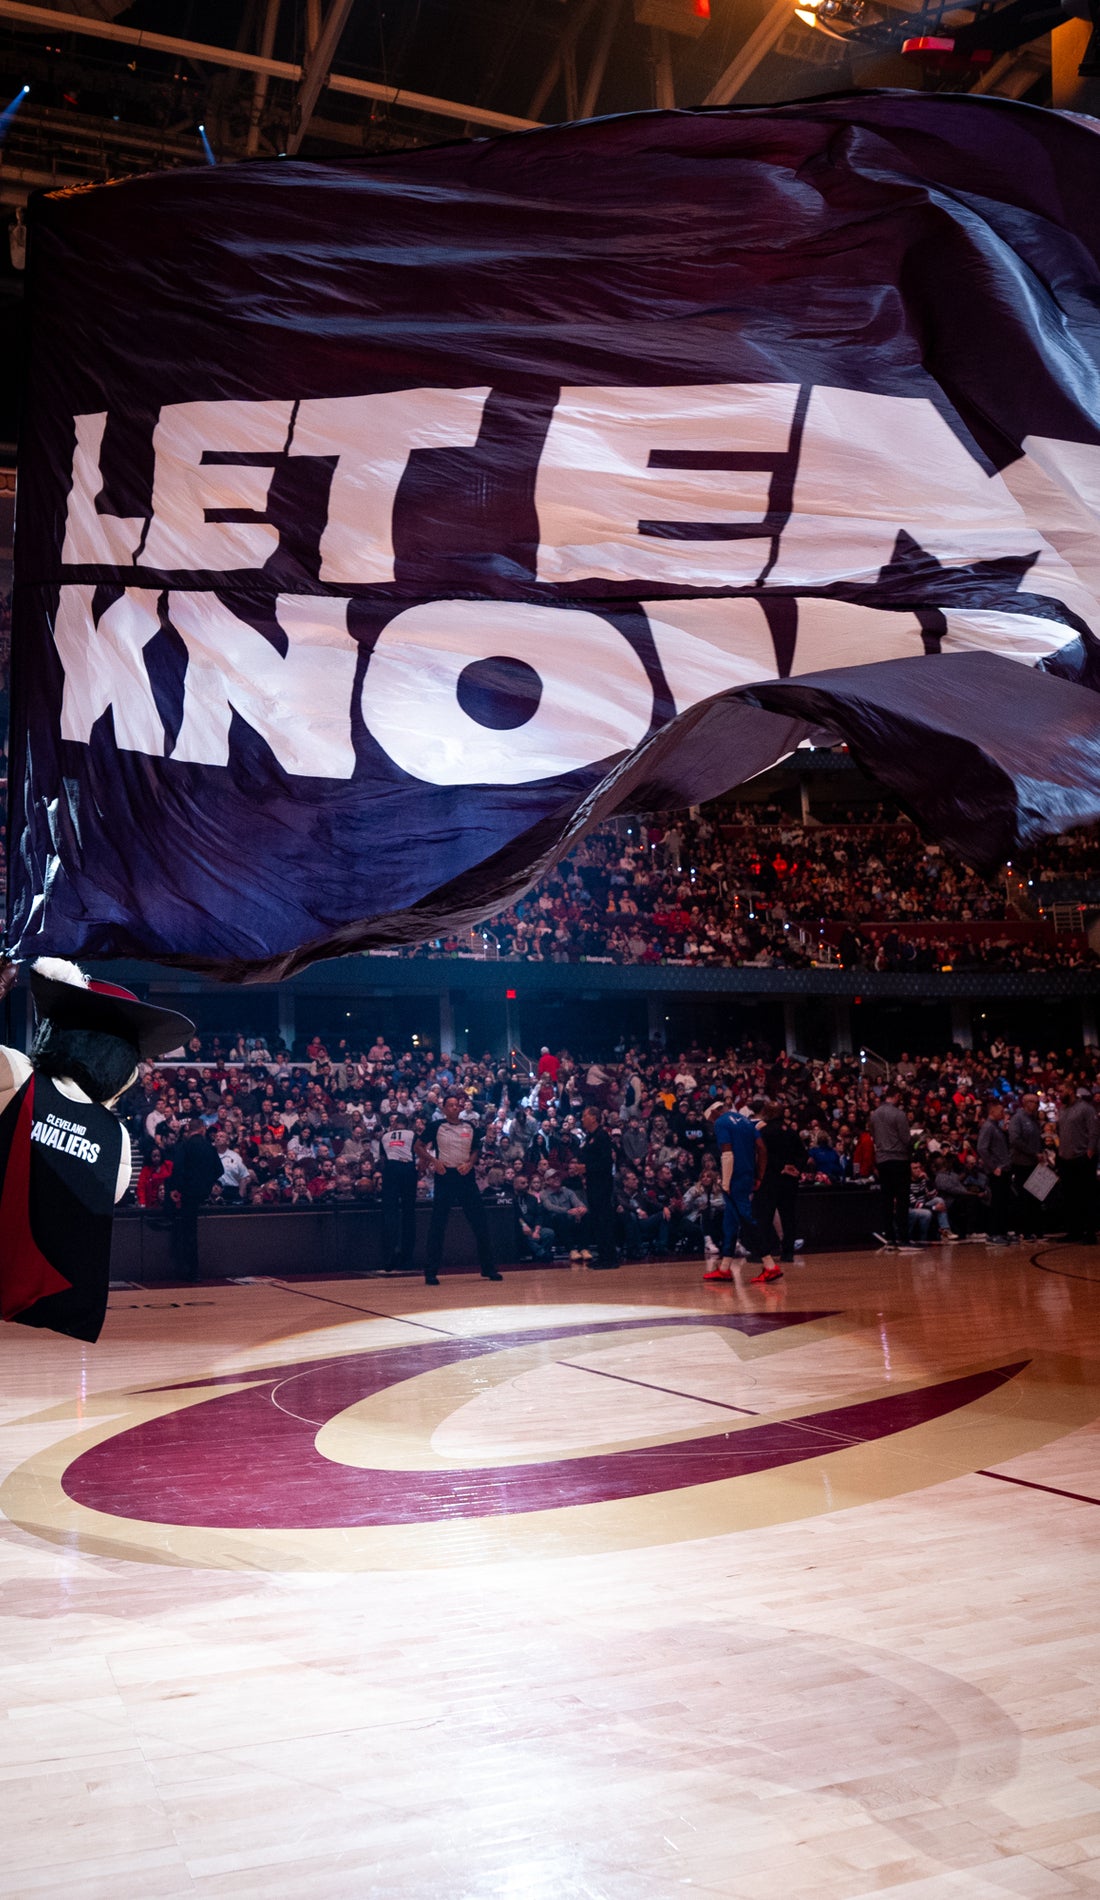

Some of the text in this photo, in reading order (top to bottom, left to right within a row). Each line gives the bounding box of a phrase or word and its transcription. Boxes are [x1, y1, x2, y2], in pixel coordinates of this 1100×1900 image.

[61, 386, 493, 583] LET
[46, 1113, 87, 1136] CLEVELAND
[390, 1132, 402, 1140] 41
[31, 1120, 101, 1164] AVALIERS
